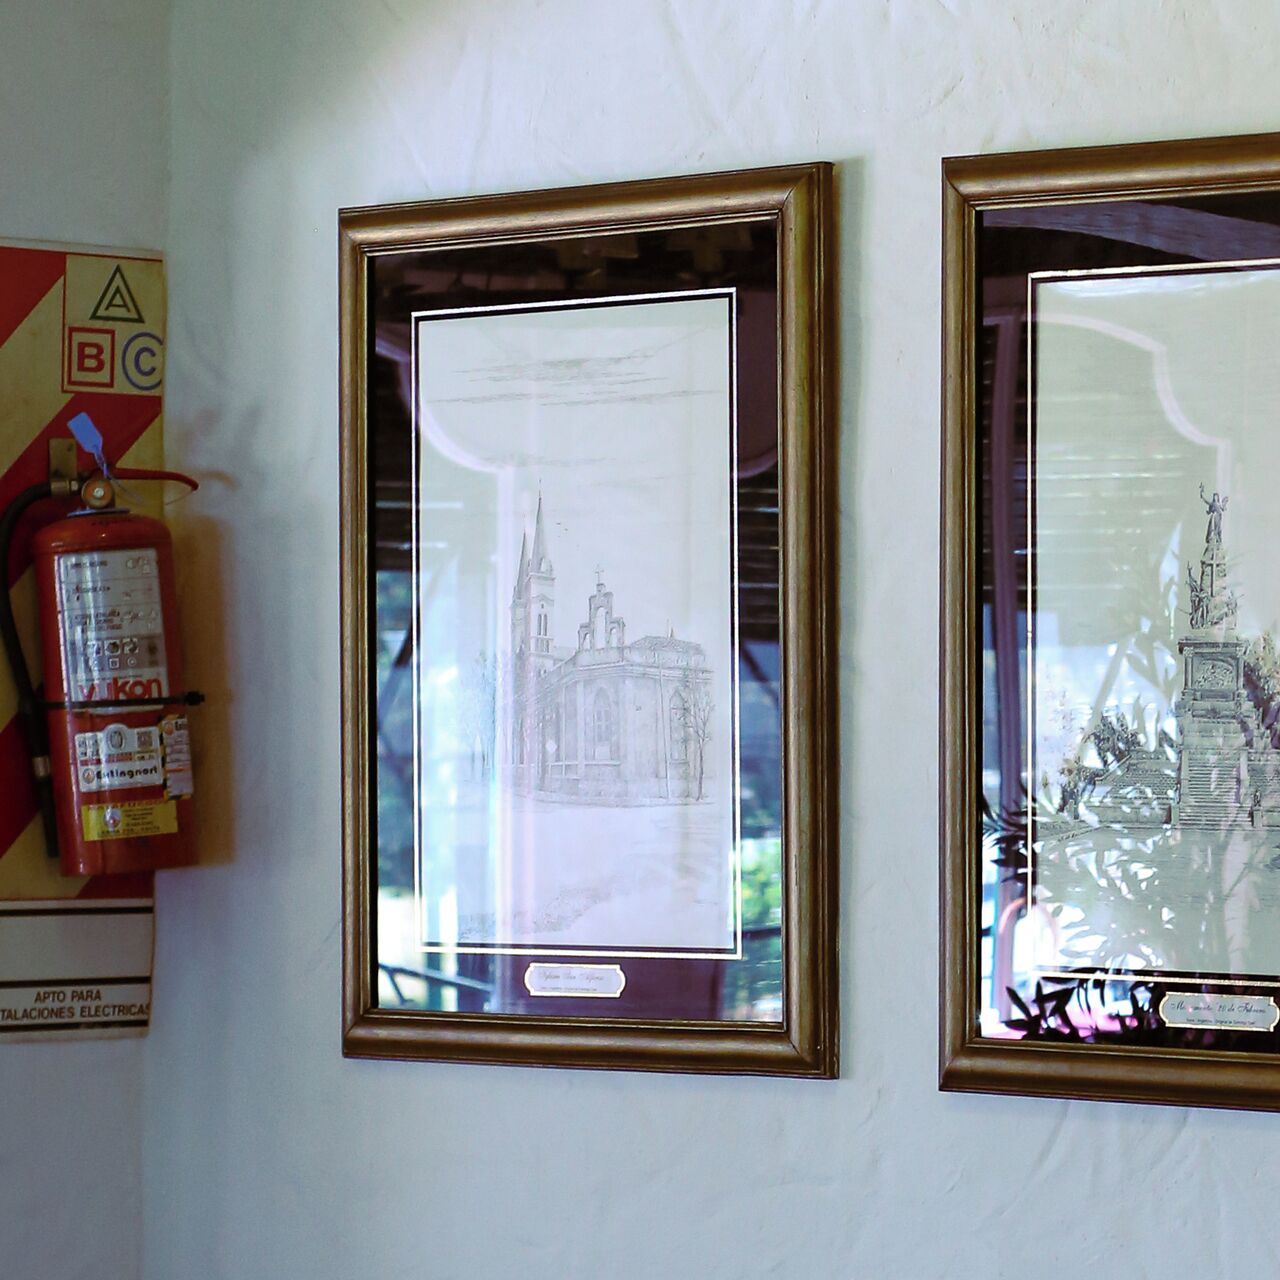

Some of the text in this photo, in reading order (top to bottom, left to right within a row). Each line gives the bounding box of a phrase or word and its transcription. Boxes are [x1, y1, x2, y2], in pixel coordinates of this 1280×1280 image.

[104, 285, 131, 313] A
[77, 341, 156, 377] B C
[34, 989, 102, 1003] APTO PARA
